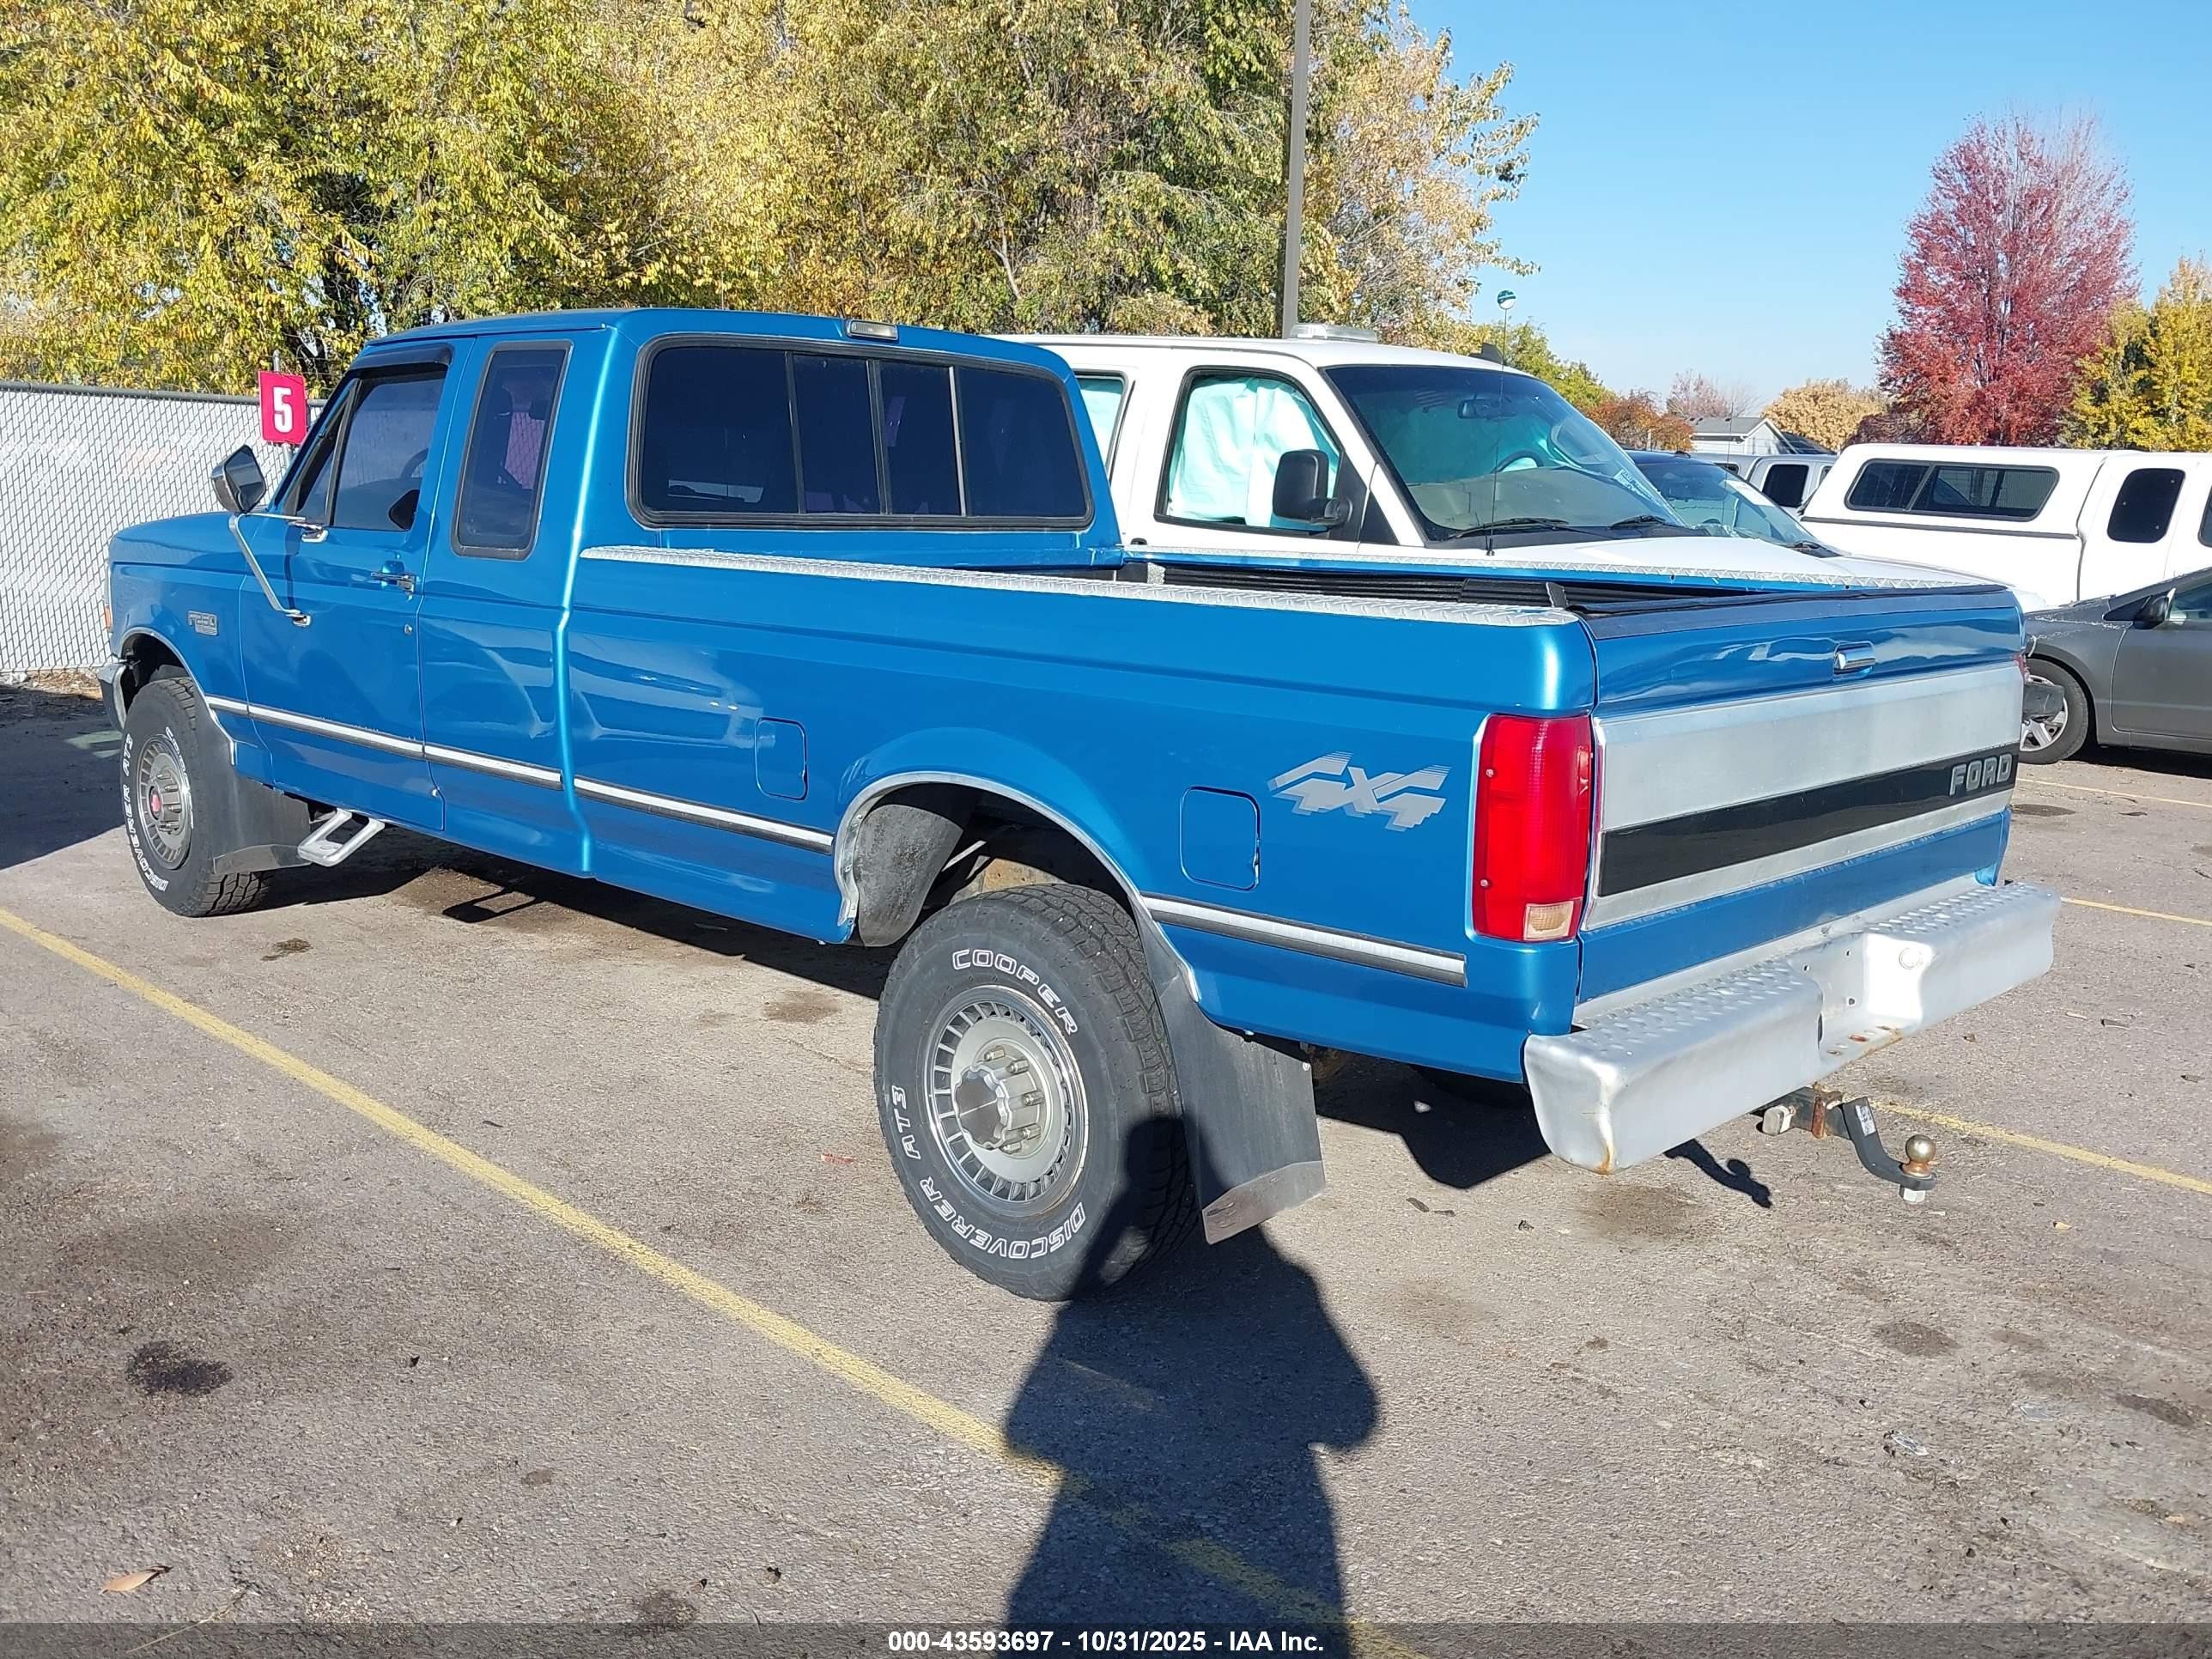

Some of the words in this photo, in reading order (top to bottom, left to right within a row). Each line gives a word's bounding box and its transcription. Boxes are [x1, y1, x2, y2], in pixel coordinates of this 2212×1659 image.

[273, 386, 293, 433] 5
[1949, 753, 2013, 796] FORD
[123, 784, 169, 891] DISCOVERER
[952, 949, 1079, 1035] COOPER
[891, 1085, 921, 1159] AT3
[920, 1176, 1086, 1259] DISCOVERER
